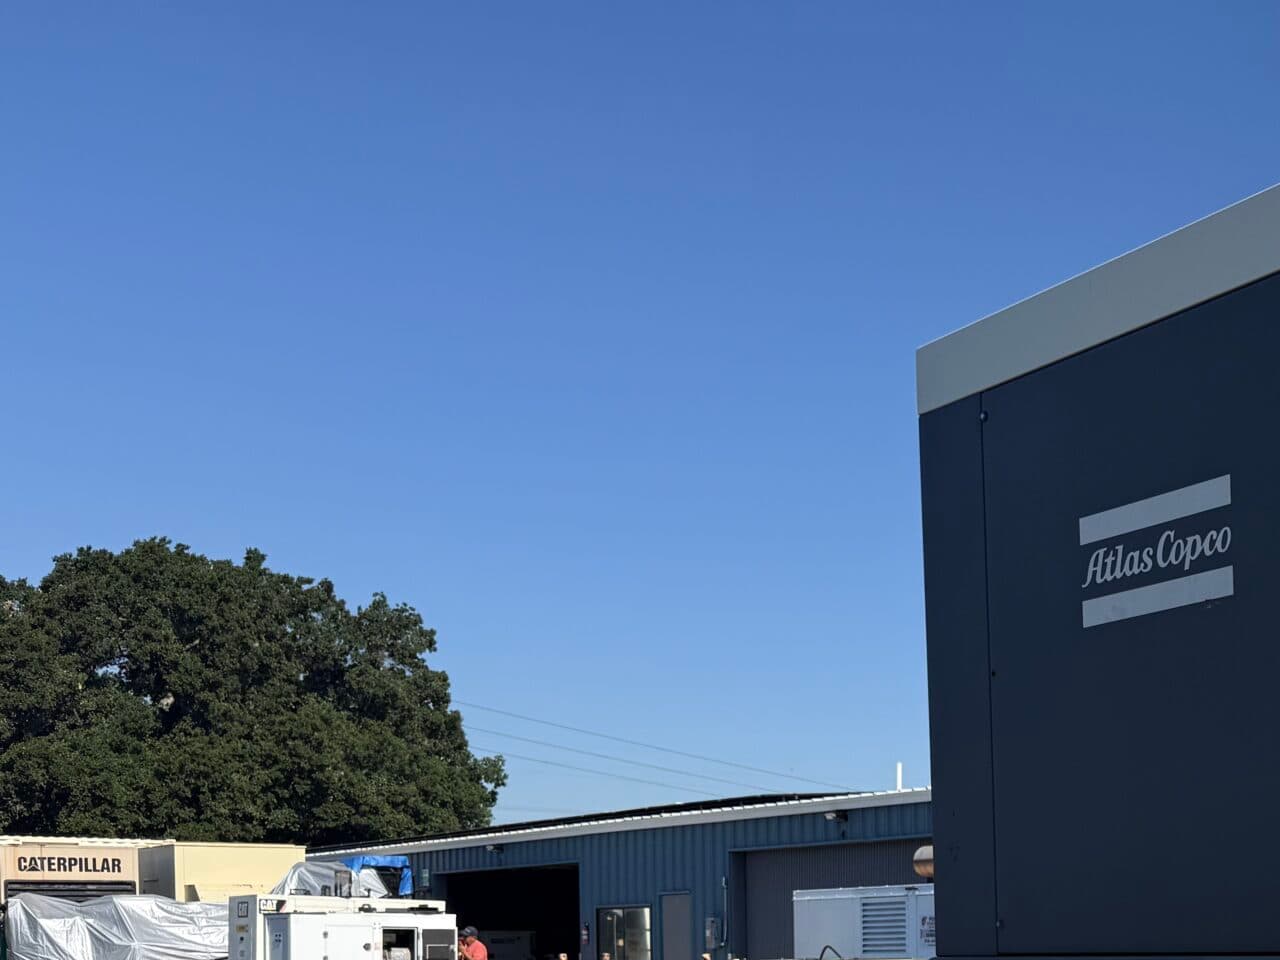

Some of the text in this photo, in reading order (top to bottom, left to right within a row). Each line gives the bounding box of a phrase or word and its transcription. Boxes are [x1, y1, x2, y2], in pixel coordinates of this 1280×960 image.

[1081, 526, 1232, 588] Atlas Copco
[17, 856, 122, 873] CATERPILLAR
[260, 900, 277, 911] CAT
